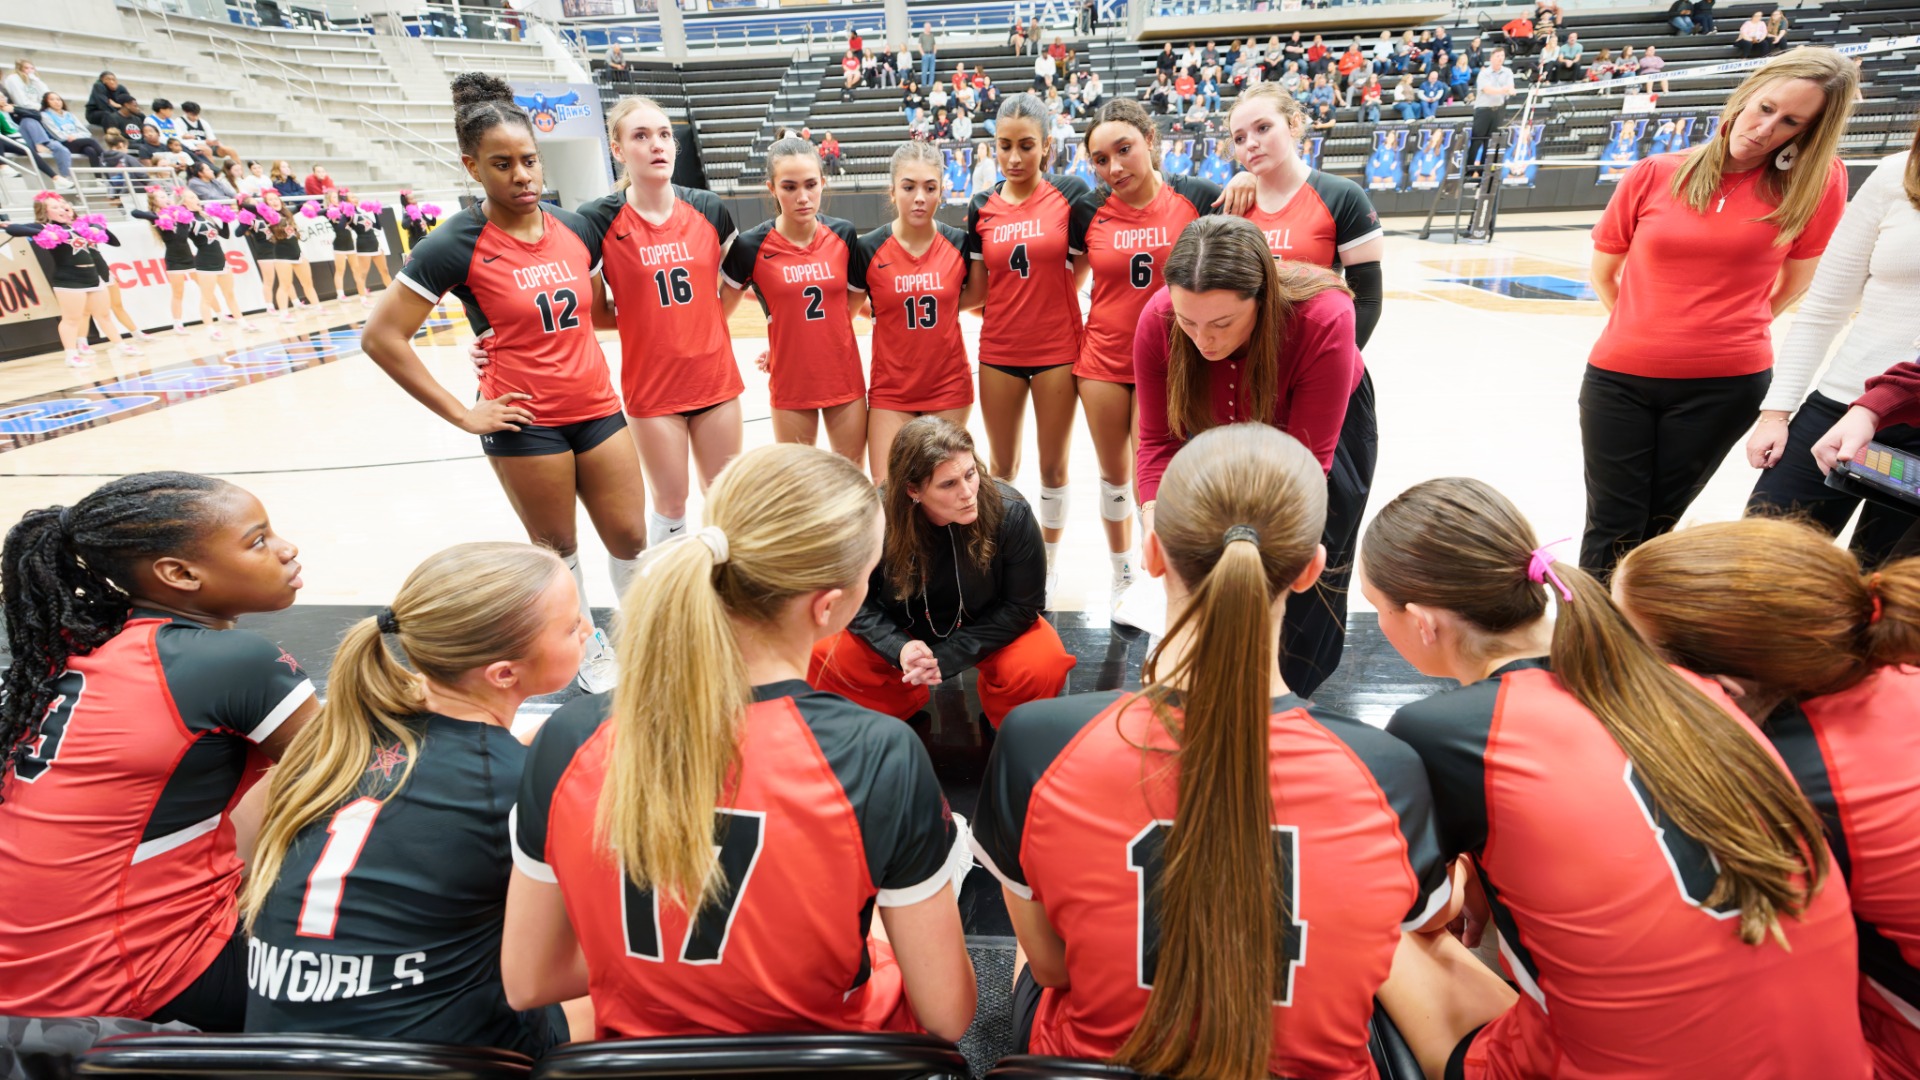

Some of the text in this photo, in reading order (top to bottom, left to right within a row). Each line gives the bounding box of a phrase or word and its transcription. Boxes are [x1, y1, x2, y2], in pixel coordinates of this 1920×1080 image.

[557, 105, 591, 122] HAWKS
[993, 218, 1044, 244] COPPELL
[1113, 226, 1171, 250] COPPELL
[639, 241, 694, 266] COPPELL
[1008, 242, 1030, 279] 4
[1129, 251, 1154, 290] 6
[512, 259, 578, 290] COPPELL
[653, 266, 694, 308] 16
[783, 261, 835, 284] COPPELL
[894, 271, 944, 294] COPPELL
[0, 268, 40, 317] ON
[534, 287, 580, 334] 12
[802, 284, 826, 321] 2
[903, 294, 938, 330] 13
[295, 795, 383, 941] 1
[247, 935, 427, 1002] OWGIRLS
